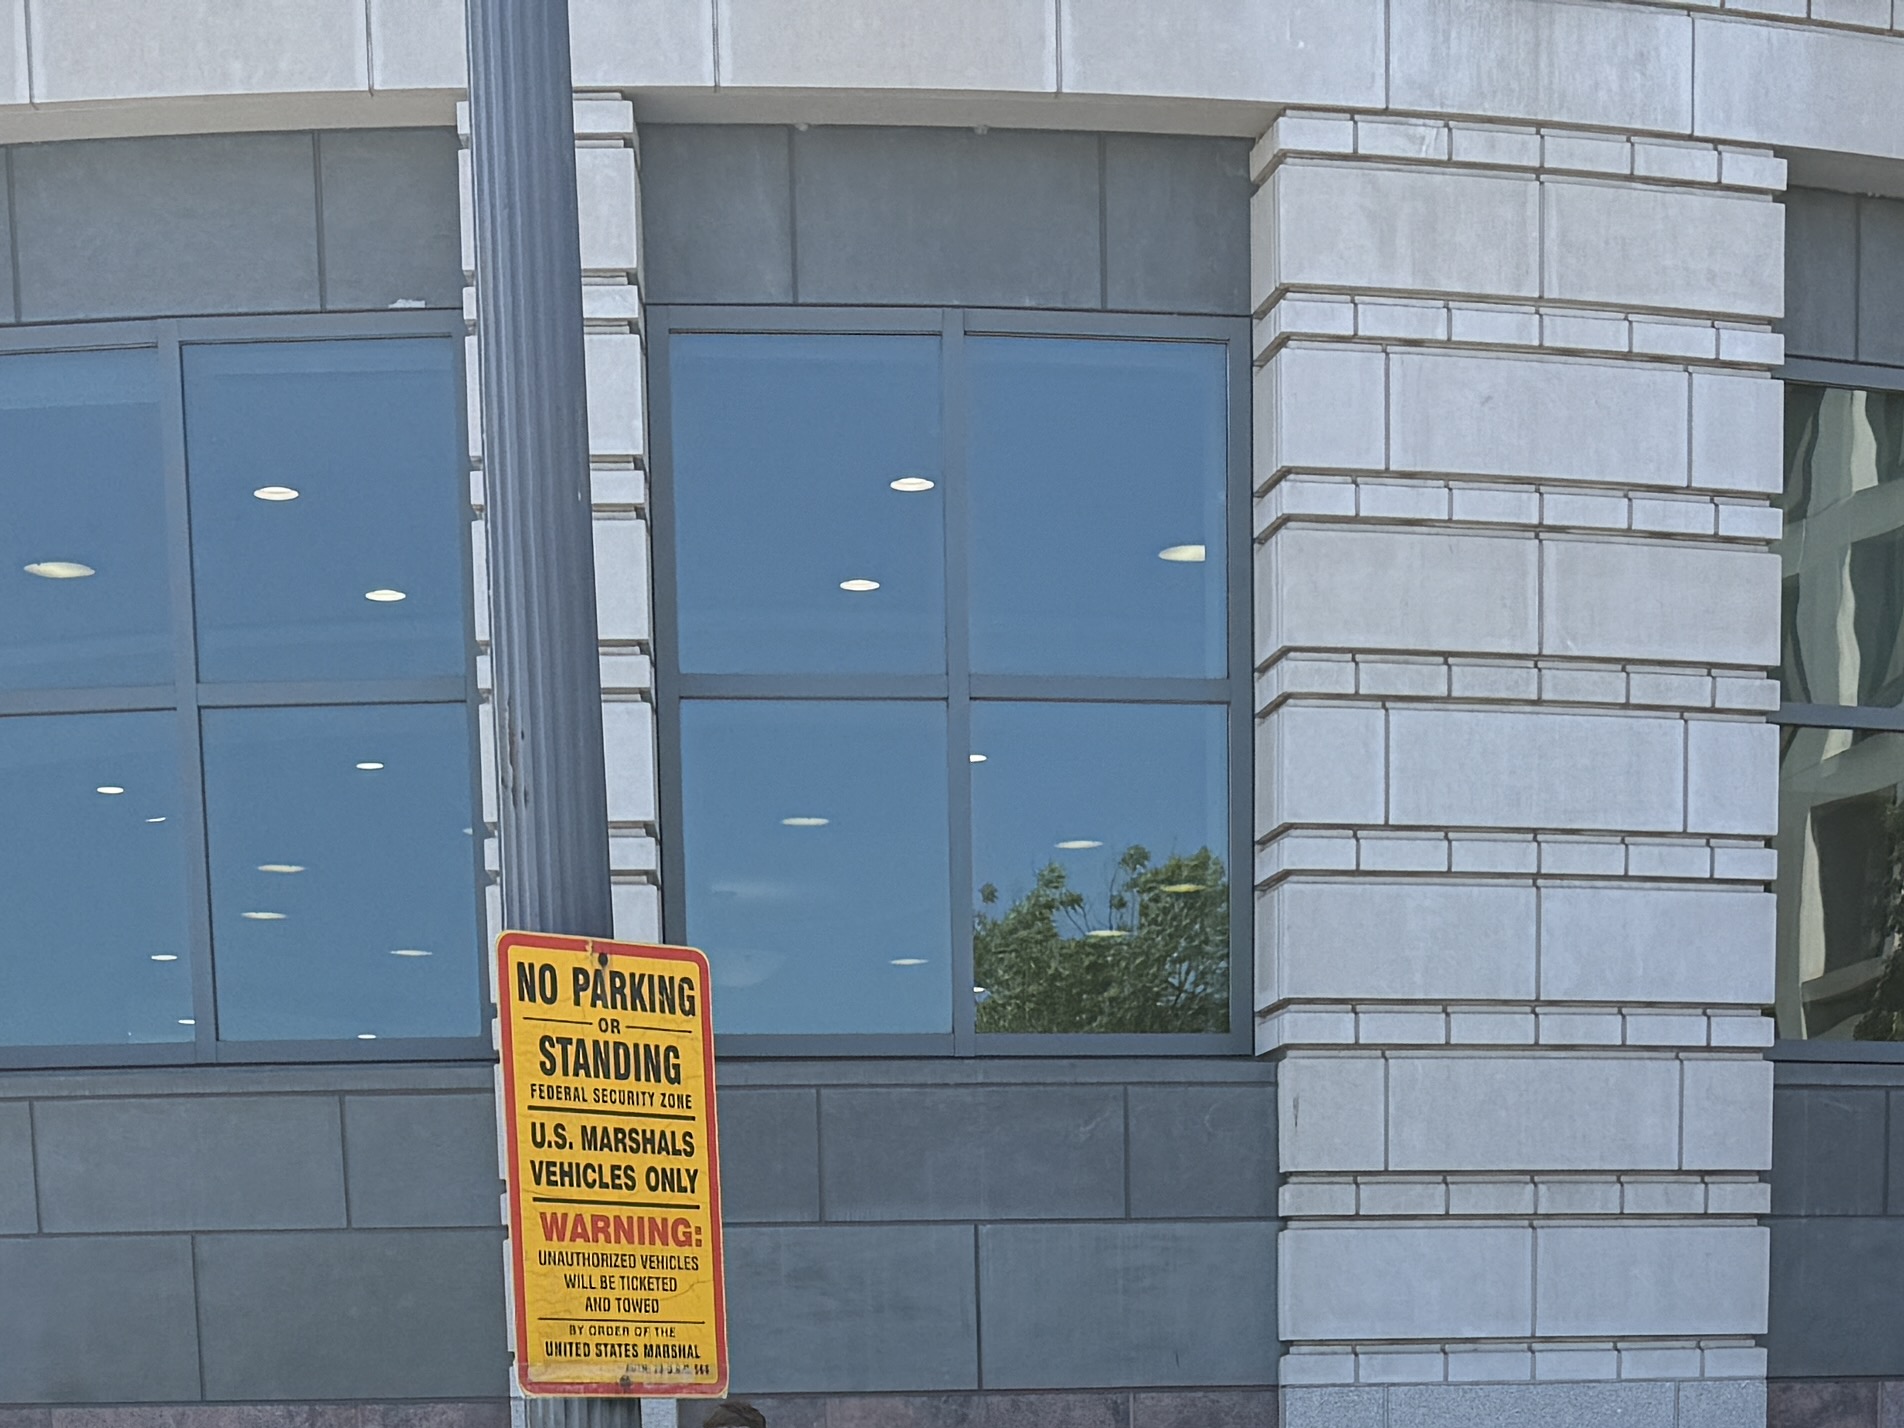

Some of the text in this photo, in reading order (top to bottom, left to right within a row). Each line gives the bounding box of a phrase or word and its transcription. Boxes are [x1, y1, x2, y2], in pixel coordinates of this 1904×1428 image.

[517, 961, 696, 1017] NO PARKING
[598, 1018, 621, 1034] OR
[539, 1035, 681, 1085] STANDING
[530, 1083, 692, 1109] FEDERAL SECURITY ZONE
[531, 1122, 695, 1157] U.S. MARSHALS
[530, 1160, 699, 1194] VEHICLES ONLY
[539, 1211, 703, 1247] WARNING:
[539, 1250, 699, 1271] UNAUTHORIZED VEHICLES
[564, 1274, 677, 1292] WILL BE TICKETED
[585, 1297, 659, 1313] AND TOWED
[569, 1325, 676, 1338] BY ORDER OF THE
[545, 1341, 701, 1359] UNITED STATES MARSHAL
